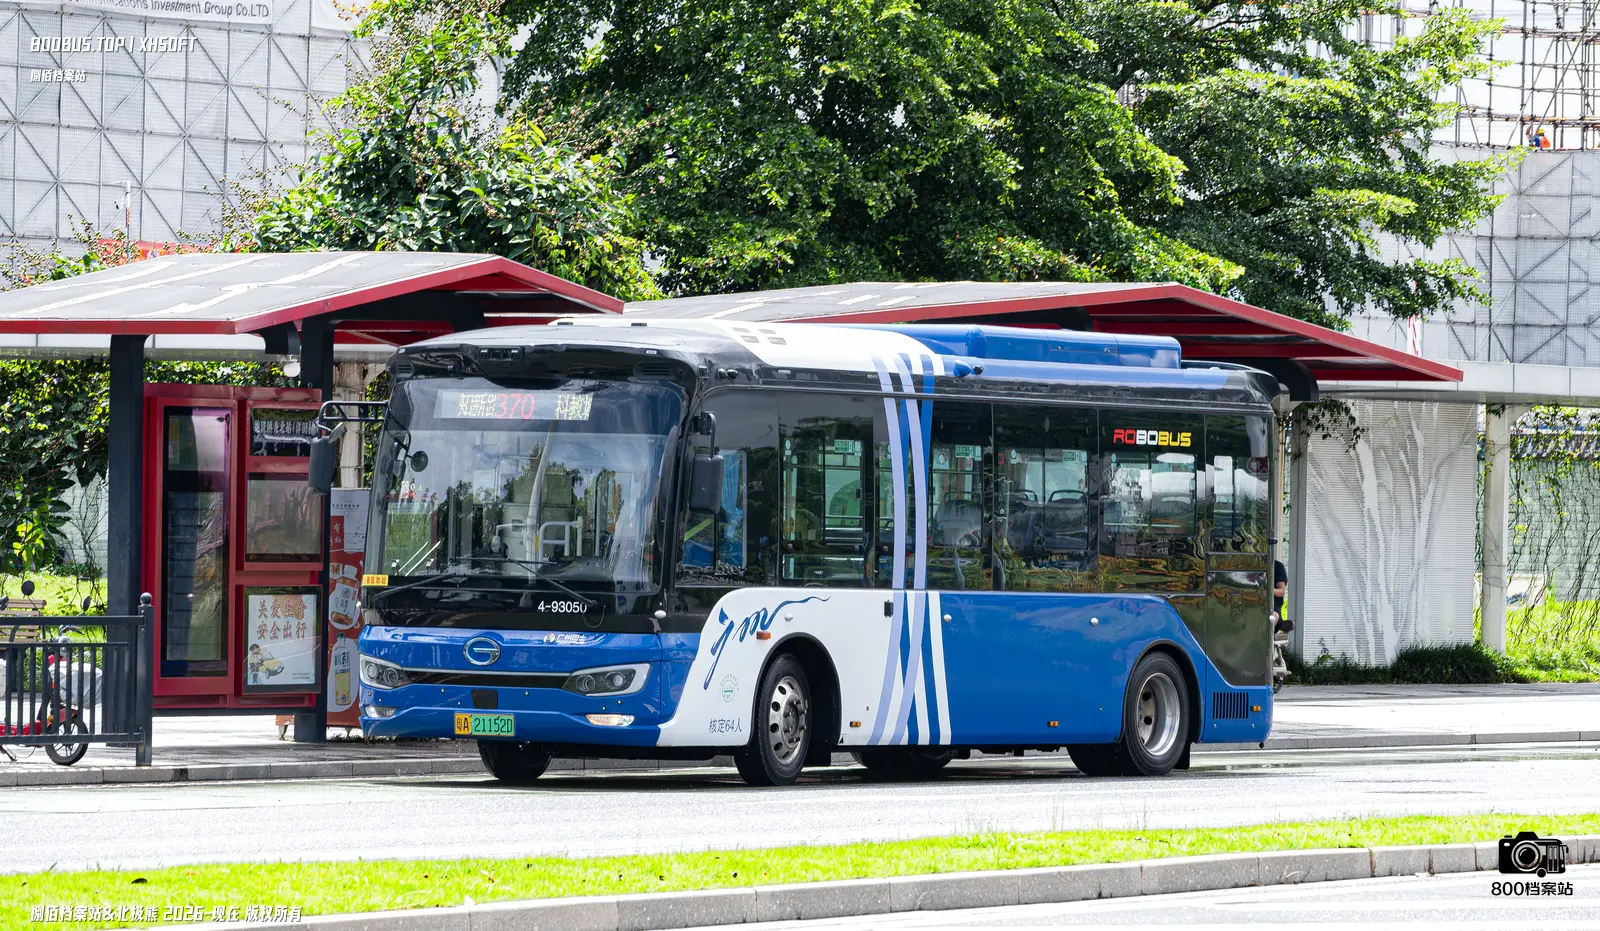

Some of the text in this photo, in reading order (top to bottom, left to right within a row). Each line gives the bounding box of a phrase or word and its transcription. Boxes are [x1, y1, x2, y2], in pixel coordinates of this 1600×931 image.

[151, 0, 201, 14] Investment
[204, 1, 233, 18] Group
[235, 3, 270, 18] Co.LTD
[495, 393, 536, 420] 370
[1113, 428, 1192, 447] ROBOBUS
[257, 598, 308, 620] 关爱生命
[537, 600, 588, 613] 4-93050
[256, 620, 308, 640] 安全出行
[556, 633, 587, 642] 广州巴士
[474, 717, 513, 733] 21152D
[709, 717, 743, 734] 核定64人
